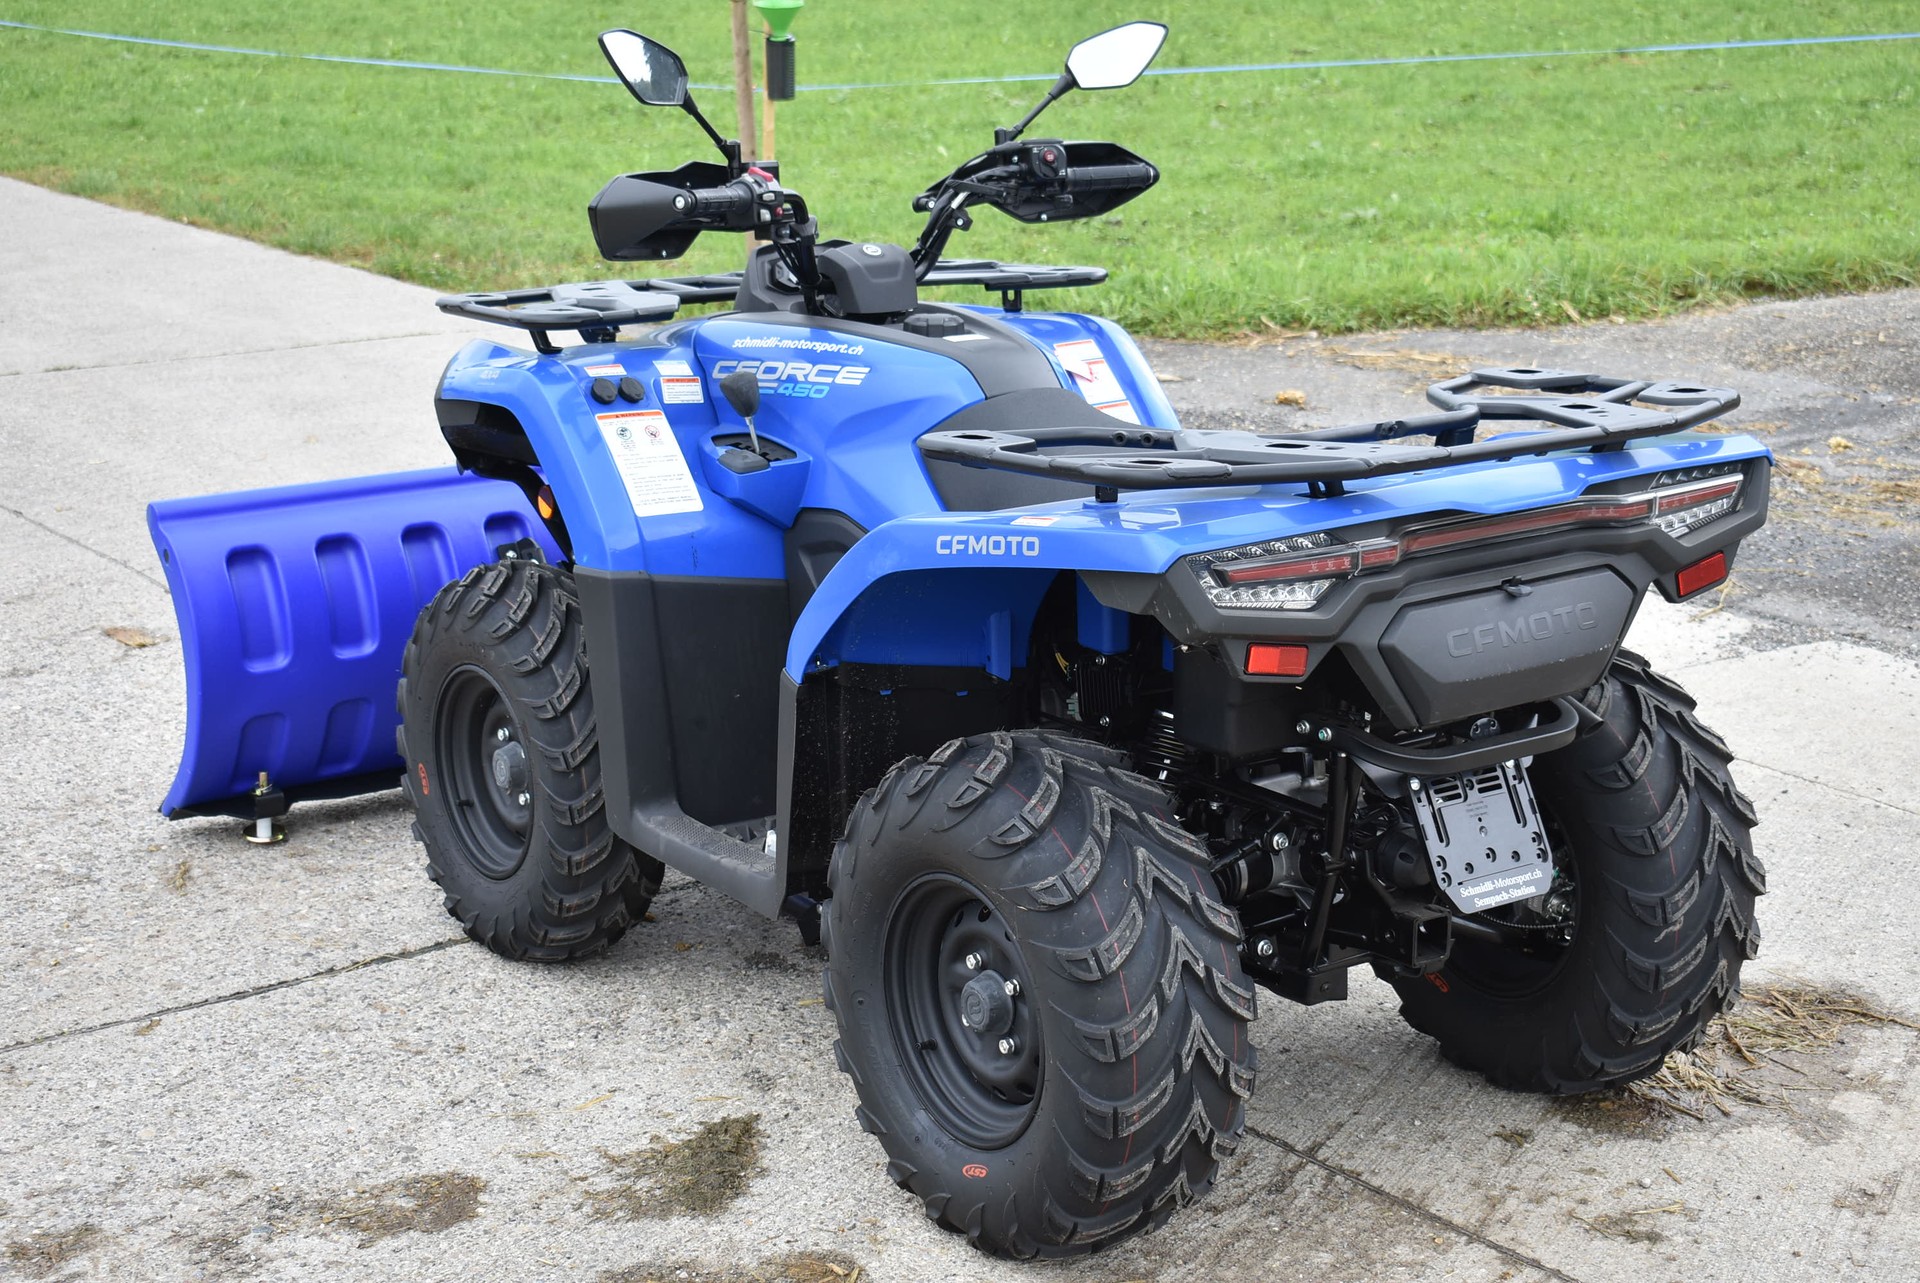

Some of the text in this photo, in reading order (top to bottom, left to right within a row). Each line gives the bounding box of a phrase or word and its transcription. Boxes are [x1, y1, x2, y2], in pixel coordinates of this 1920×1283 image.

[732, 336, 865, 356] schmidli-motorsport.ch
[776, 382, 830, 399] 450
[936, 535, 1040, 557] CFMOTO
[1446, 601, 1599, 659] CFMOTO
[1459, 868, 1543, 898] Schmidli-Motorsport.ch
[1473, 884, 1537, 908] Sempach-Station
